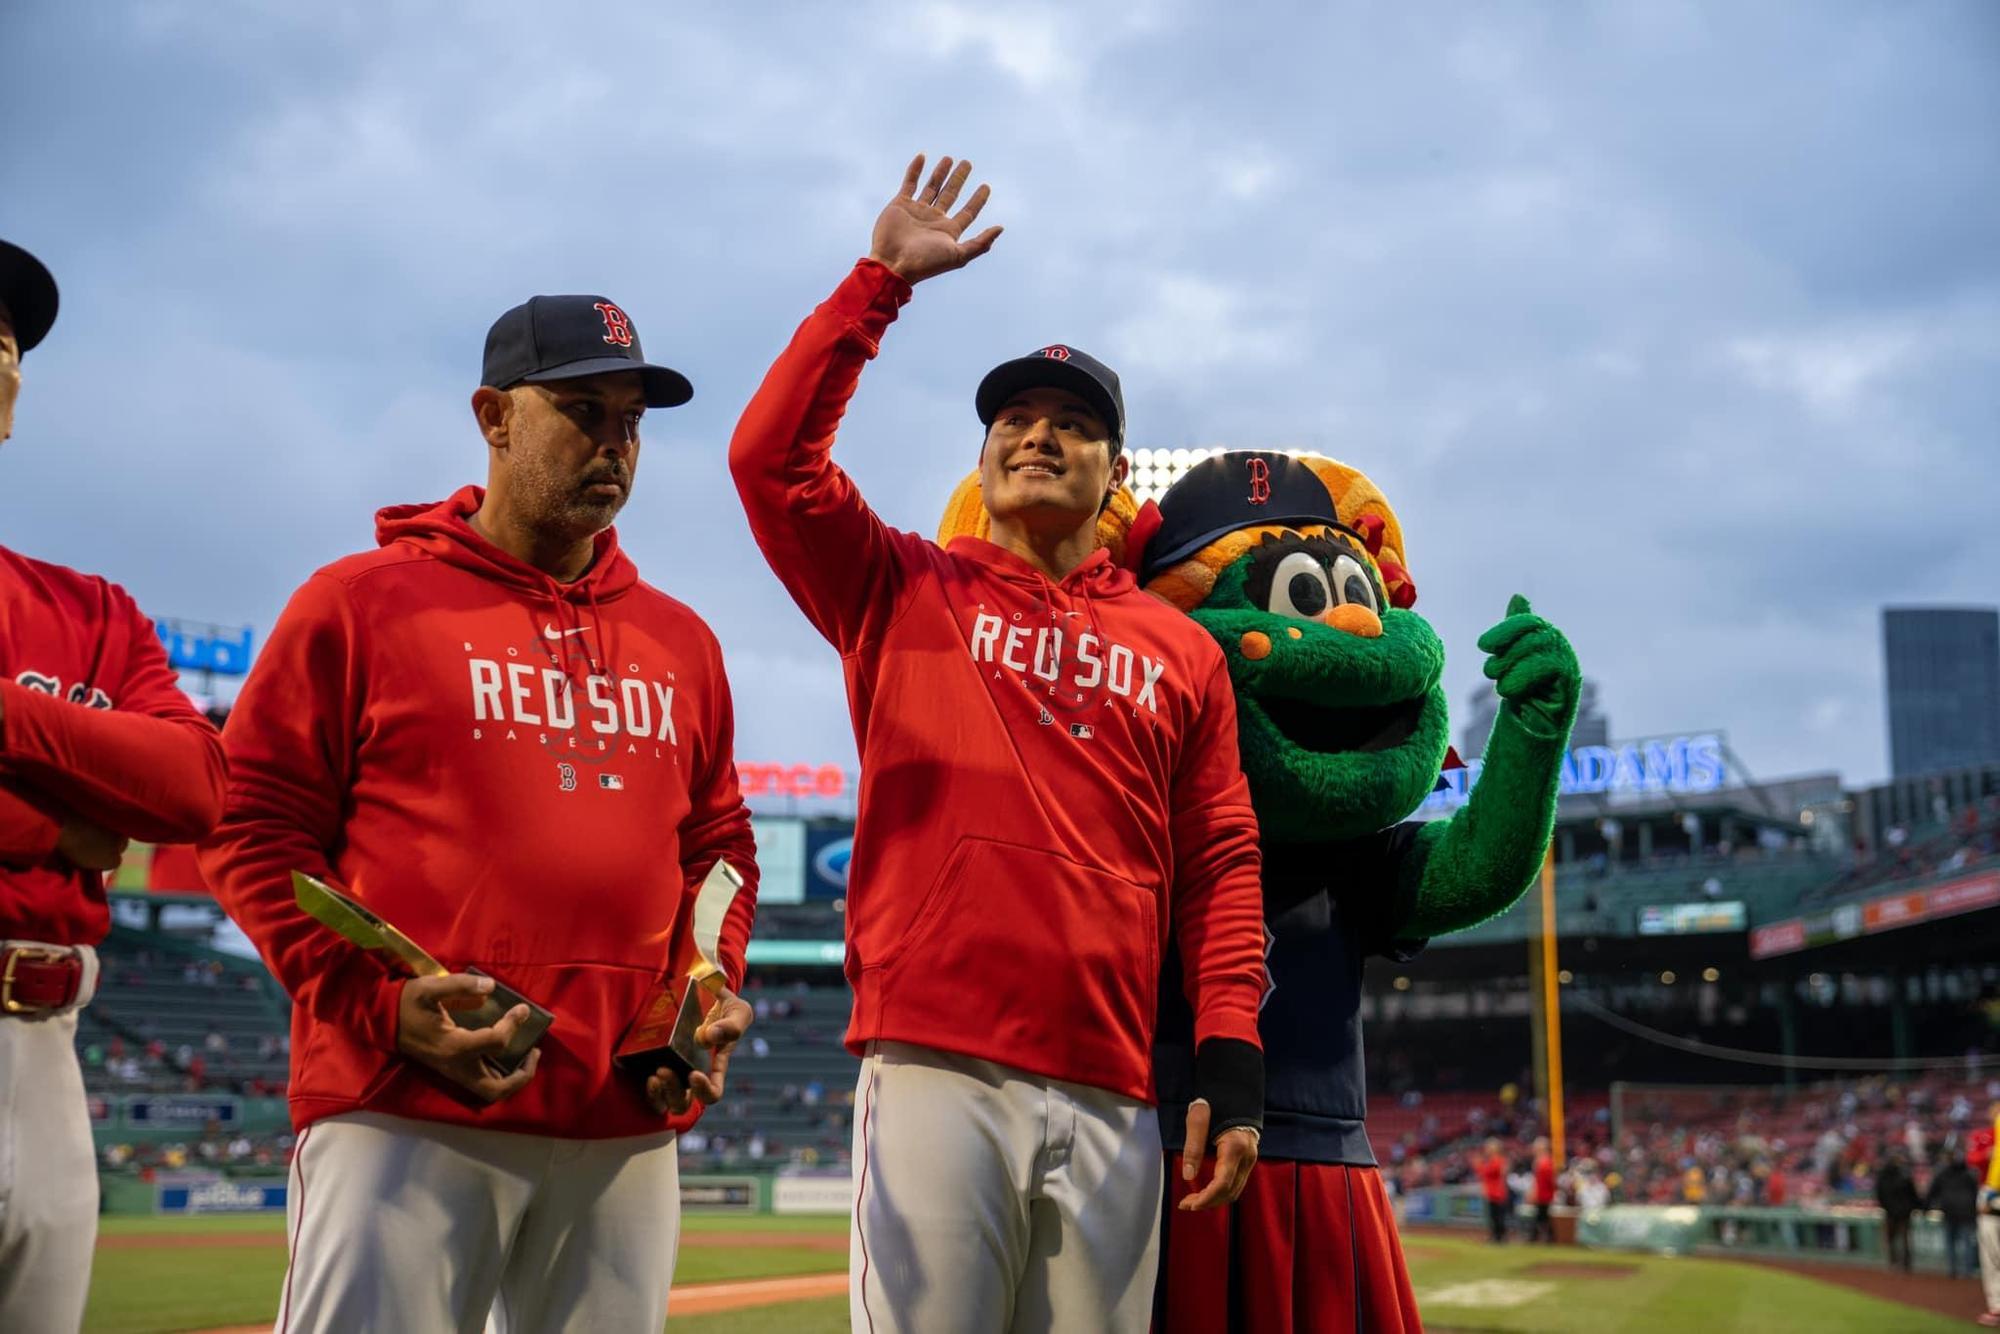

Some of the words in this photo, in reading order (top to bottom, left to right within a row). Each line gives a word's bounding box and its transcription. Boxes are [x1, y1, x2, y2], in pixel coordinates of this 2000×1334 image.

[593, 303, 633, 347] B
[1245, 458, 1271, 505] B
[464, 642, 675, 681] BOSTON
[971, 613, 1063, 681] RED
[1074, 633, 1165, 714] SOX
[469, 659, 575, 729] RED
[586, 675, 677, 746] SOX
[557, 763, 577, 791] B
